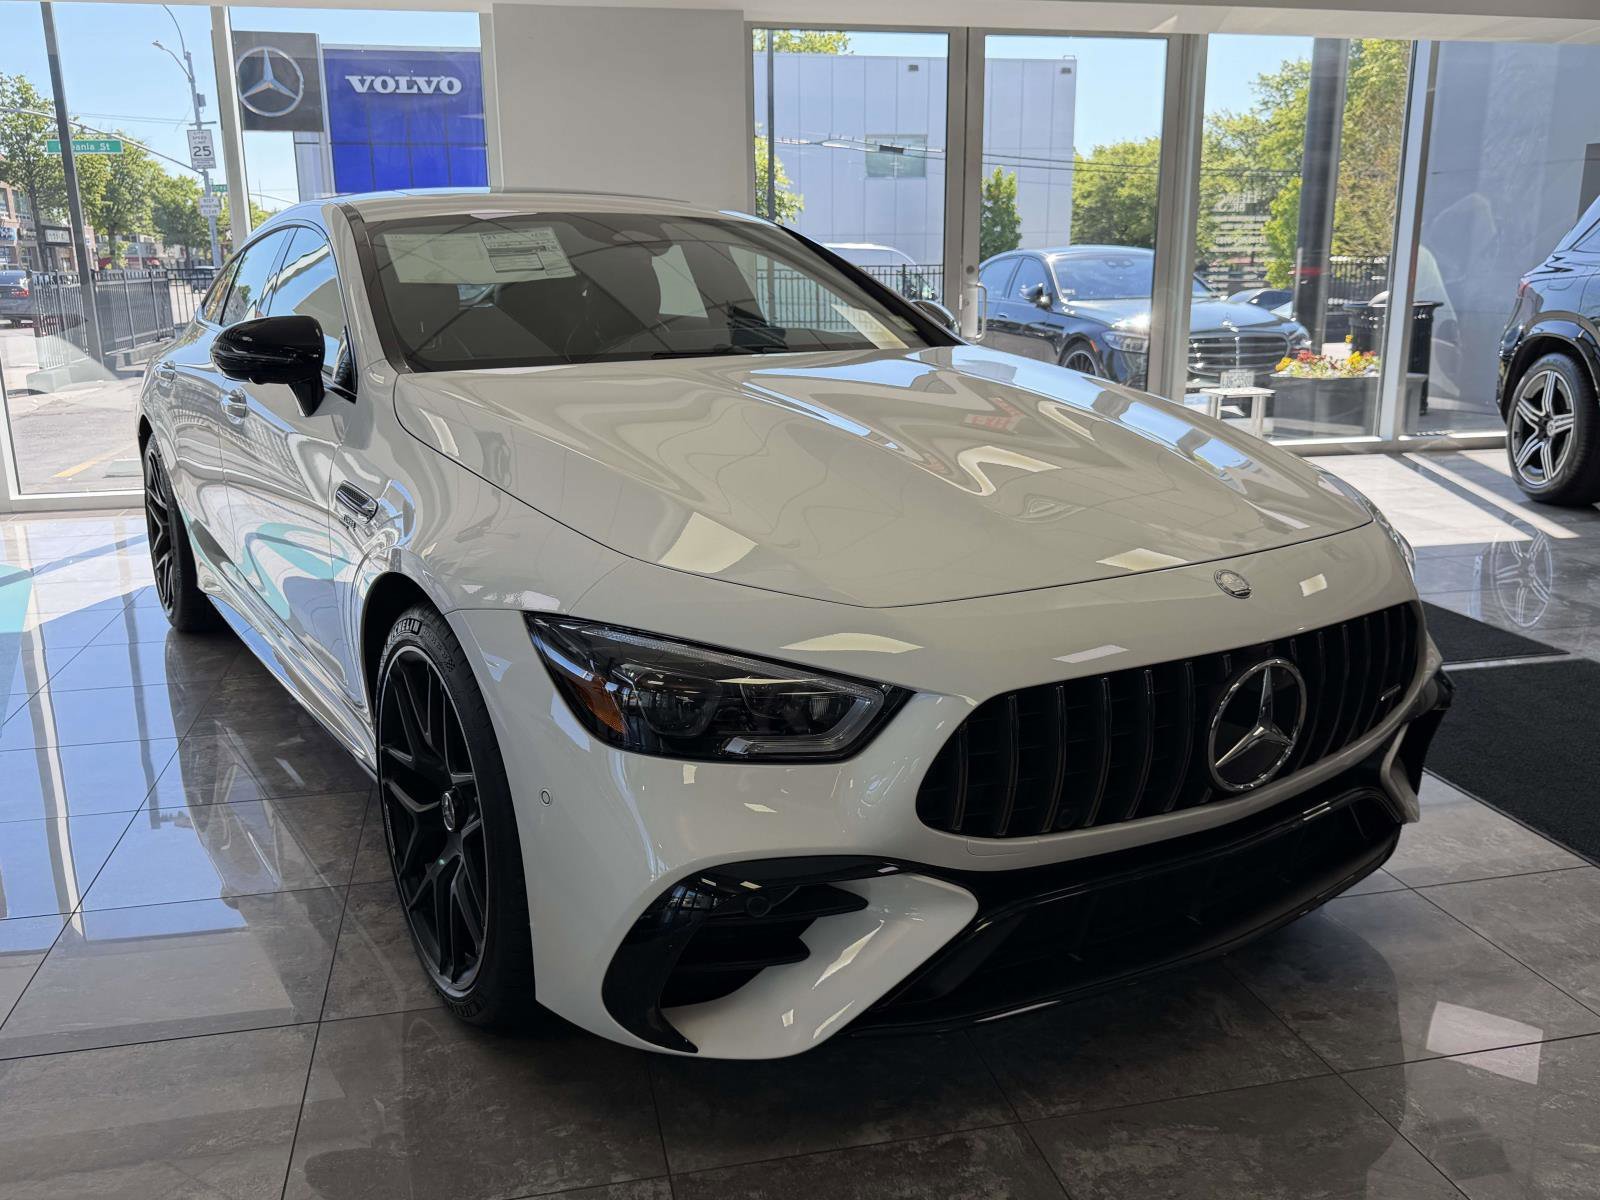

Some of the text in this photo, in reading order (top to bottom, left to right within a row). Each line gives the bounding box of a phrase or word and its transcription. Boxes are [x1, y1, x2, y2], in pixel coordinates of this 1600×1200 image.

[345, 75, 462, 95] VOLVO
[100, 142, 110, 151] St
[192, 145, 212, 157] 25
